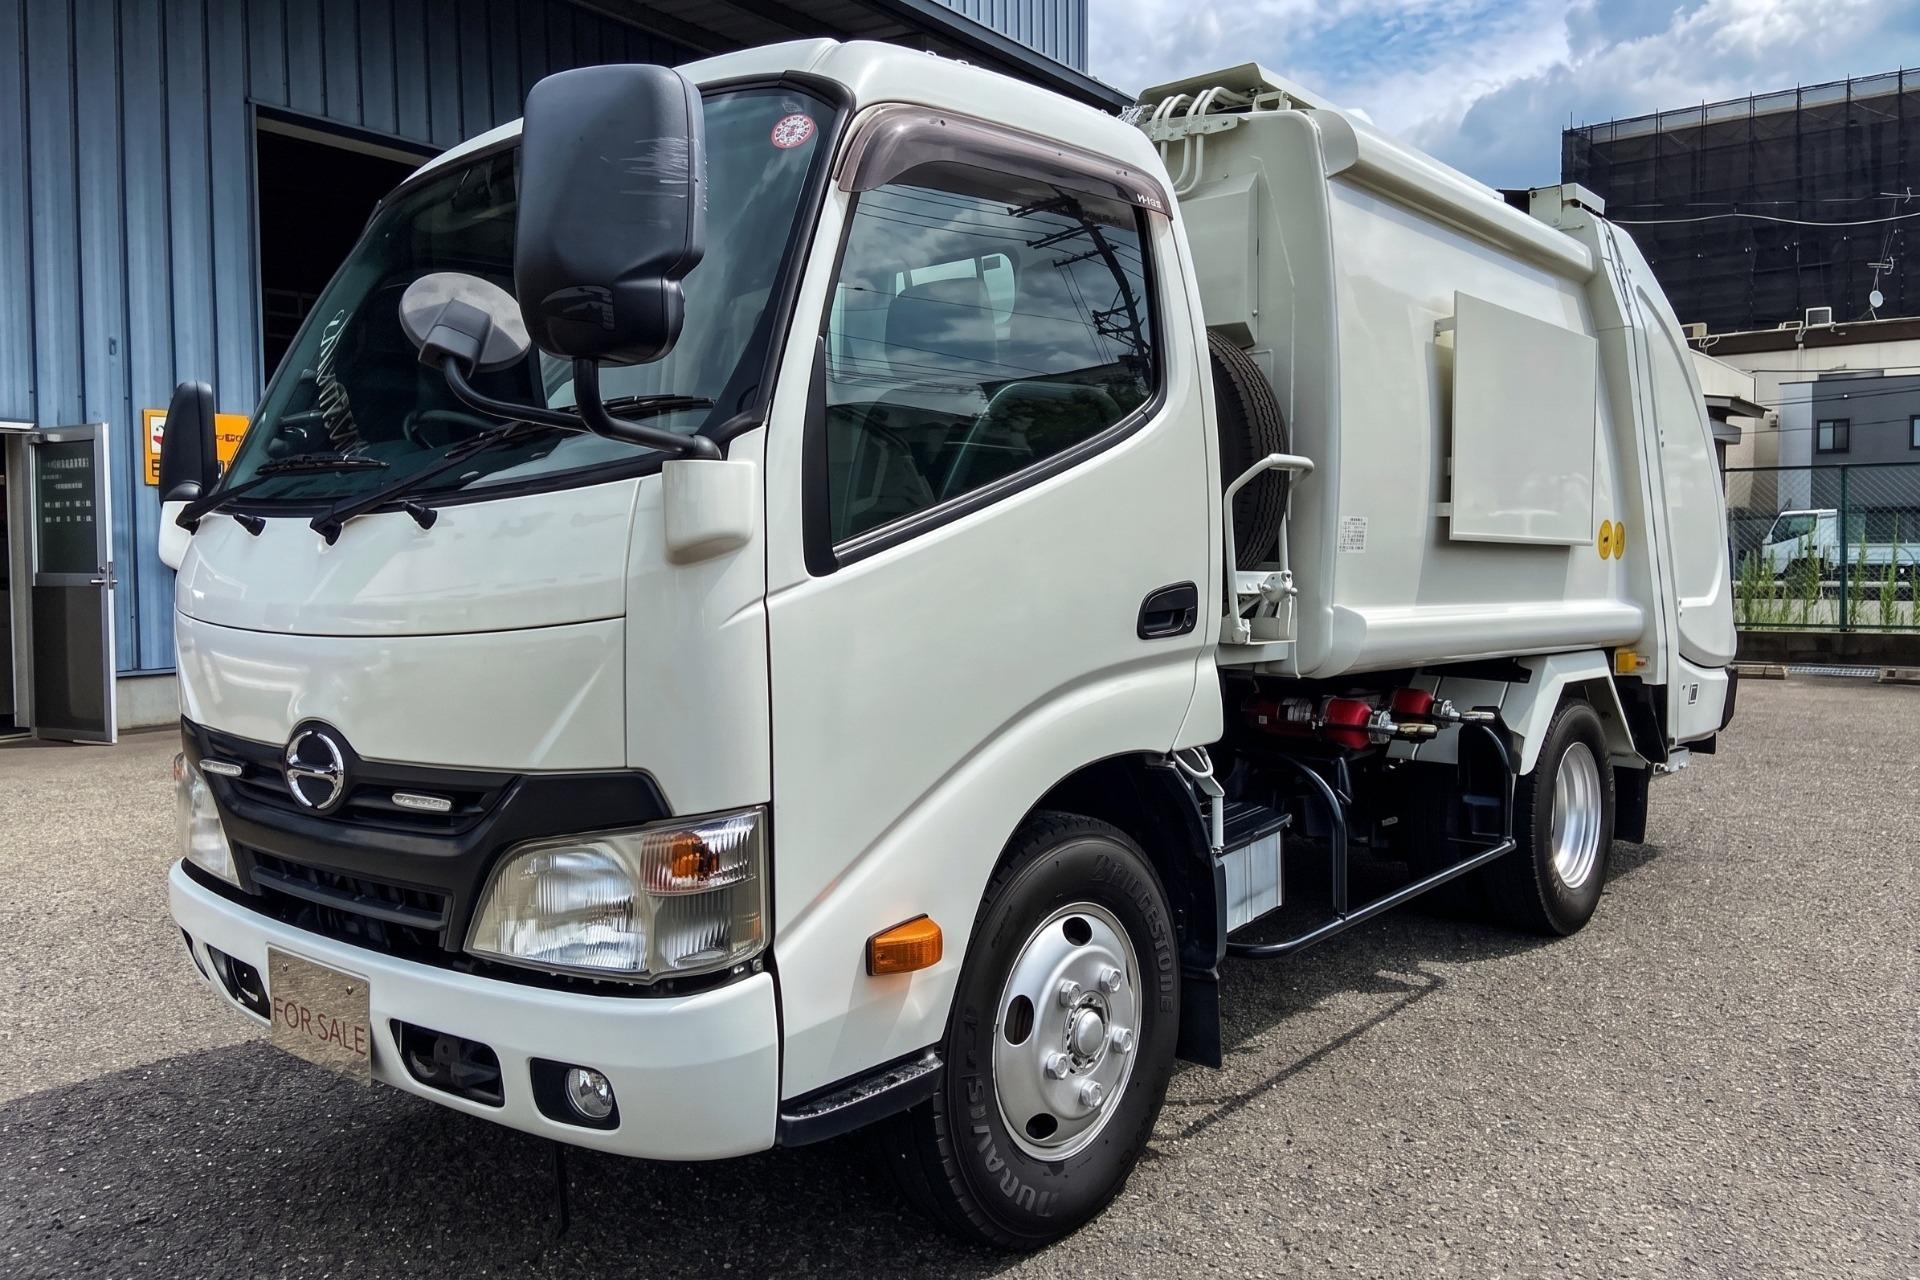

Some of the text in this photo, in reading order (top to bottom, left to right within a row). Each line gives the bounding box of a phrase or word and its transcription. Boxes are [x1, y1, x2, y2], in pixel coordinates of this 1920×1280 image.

[1091, 854, 1174, 1014] BRIDGESTONE
[273, 997, 367, 1056] FOR SALE
